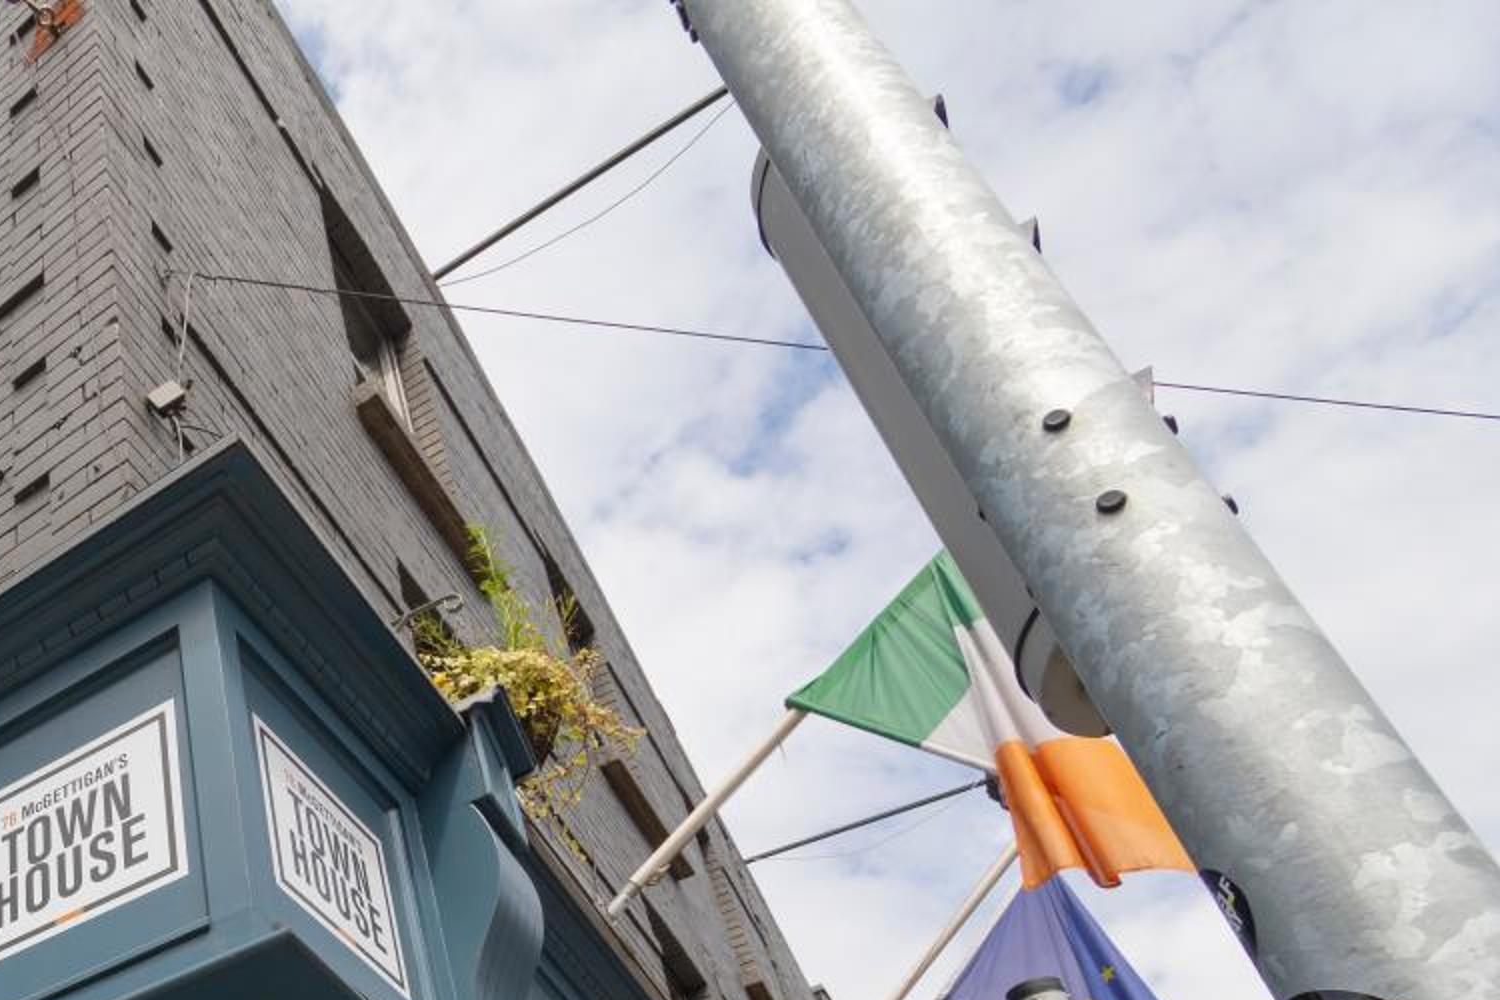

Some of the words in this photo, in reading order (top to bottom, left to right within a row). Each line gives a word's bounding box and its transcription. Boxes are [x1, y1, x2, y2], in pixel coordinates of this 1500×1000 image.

[1, 772, 132, 876] TOWN
[21, 753, 128, 820] McGETTIGAN'S
[287, 787, 373, 902] TOWN
[289, 828, 387, 955] HOUSE
